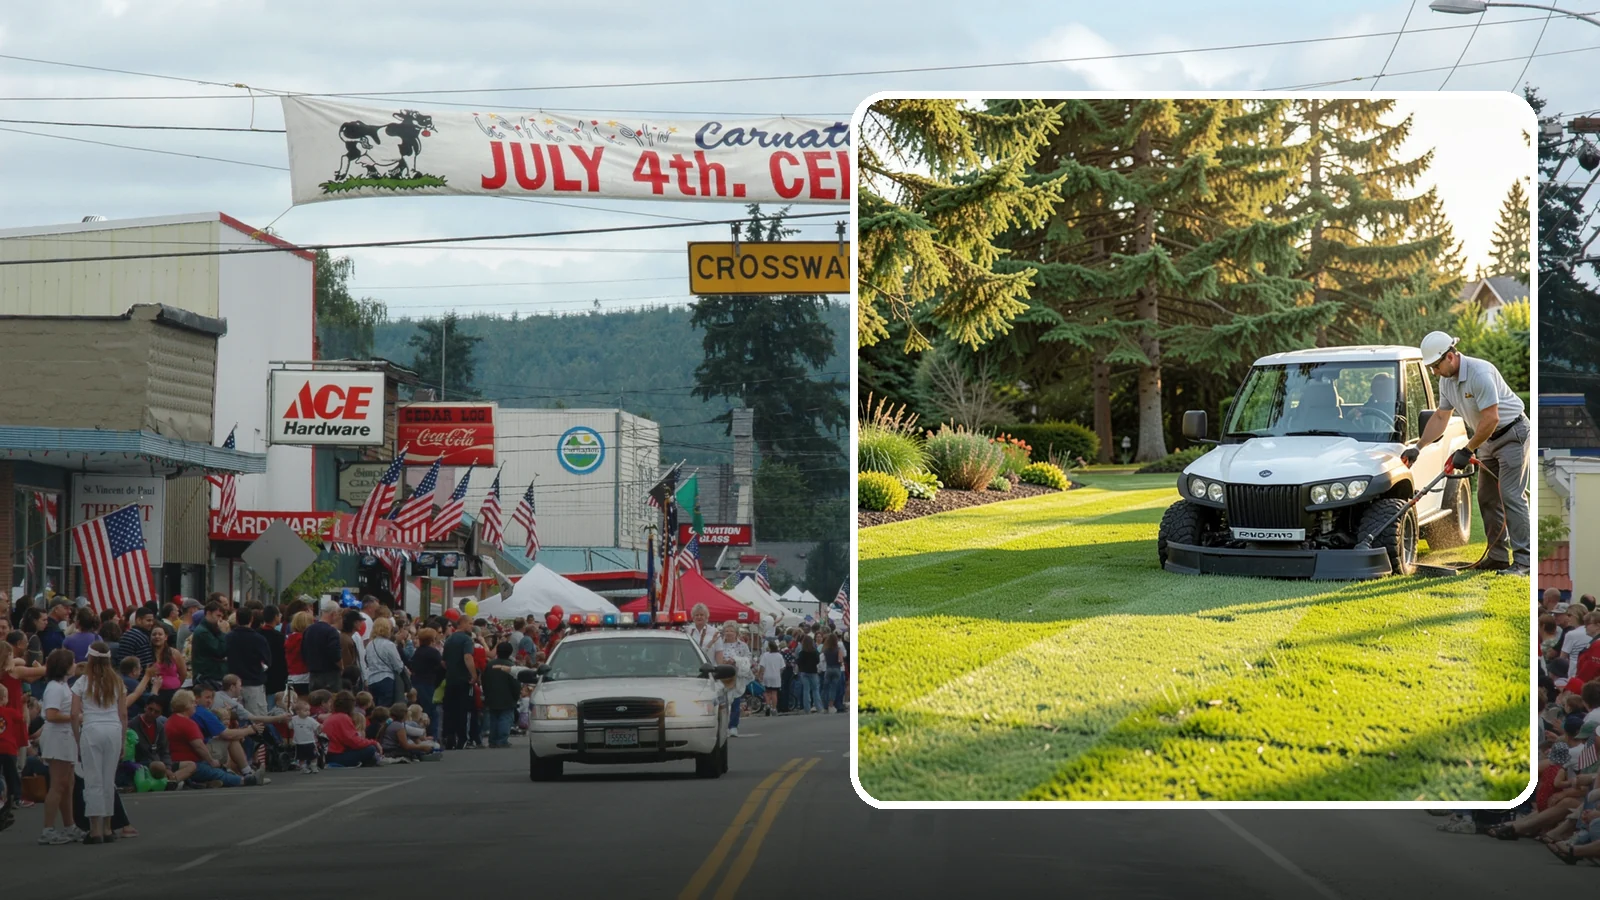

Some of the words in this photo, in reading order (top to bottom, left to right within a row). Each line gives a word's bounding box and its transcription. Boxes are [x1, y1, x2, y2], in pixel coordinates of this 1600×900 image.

[695, 121, 850, 150] Carnat
[481, 141, 605, 193] JULY
[632, 150, 746, 198] 4th.
[697, 254, 850, 280] CROSSWA
[282, 380, 373, 420] ACE
[405, 409, 452, 422] CEDAR
[461, 409, 485, 422] LOG
[283, 421, 371, 436] Hardware
[416, 428, 477, 447] Coca-Cola
[353, 467, 385, 480] Simpl
[95, 485, 124, 494] Vincent
[126, 486, 136, 495] de
[137, 486, 155, 495] Paul
[688, 526, 741, 535] CRNATION
[699, 535, 730, 543] GLASS
